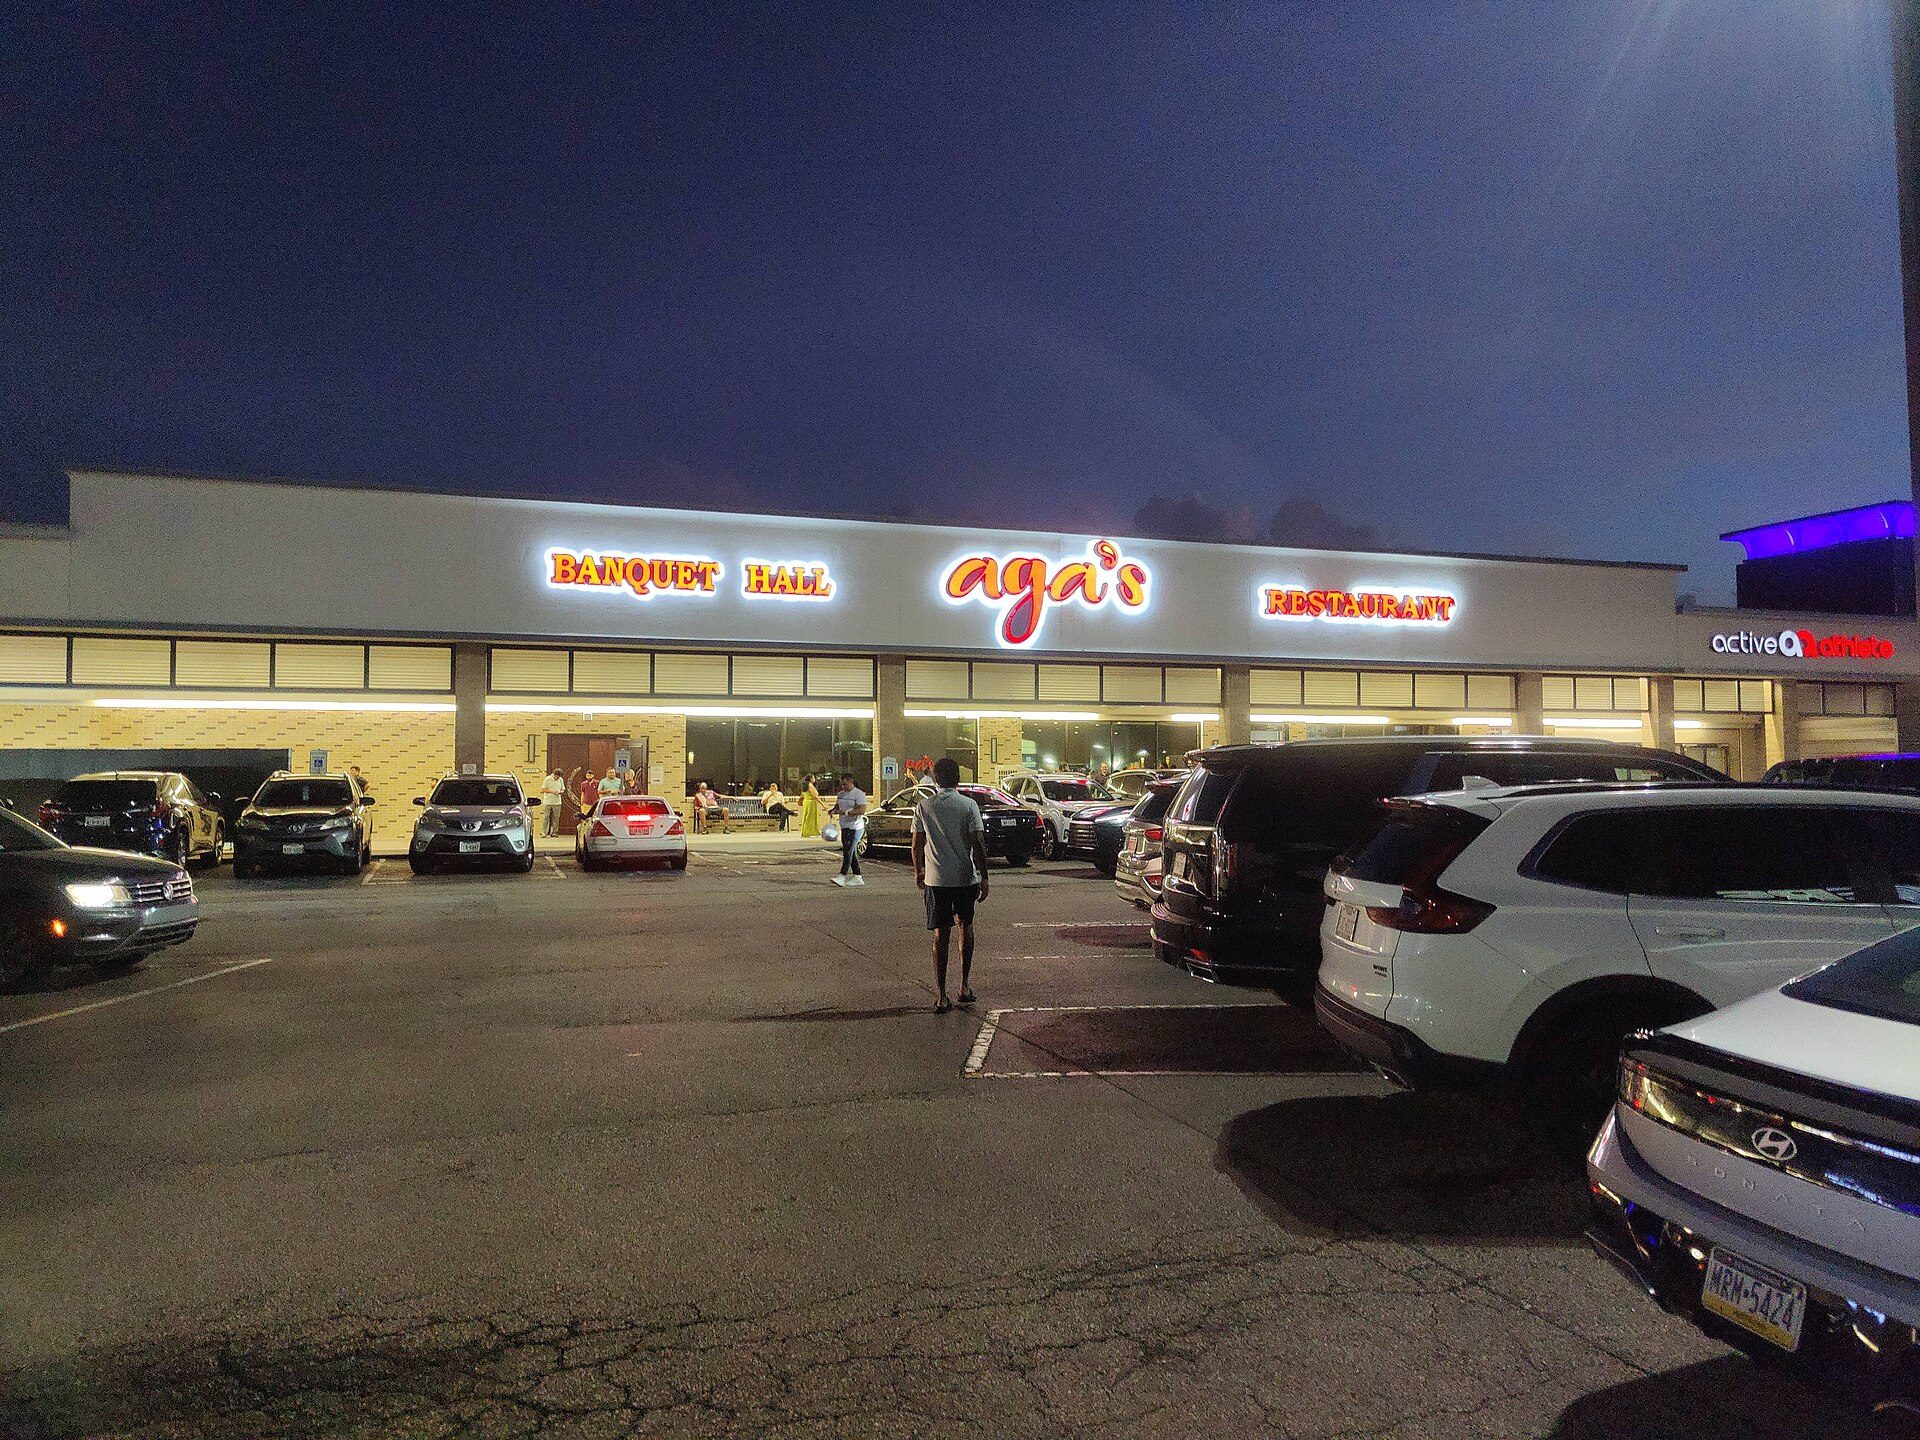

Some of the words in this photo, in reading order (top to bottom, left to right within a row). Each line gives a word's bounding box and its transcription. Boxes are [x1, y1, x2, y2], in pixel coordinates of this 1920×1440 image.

[551, 553, 720, 595] BANQUET
[745, 563, 832, 597] HALL
[946, 540, 1147, 645] aga's
[1266, 588, 1457, 622] RESTAURANT
[1712, 631, 1778, 655] active
